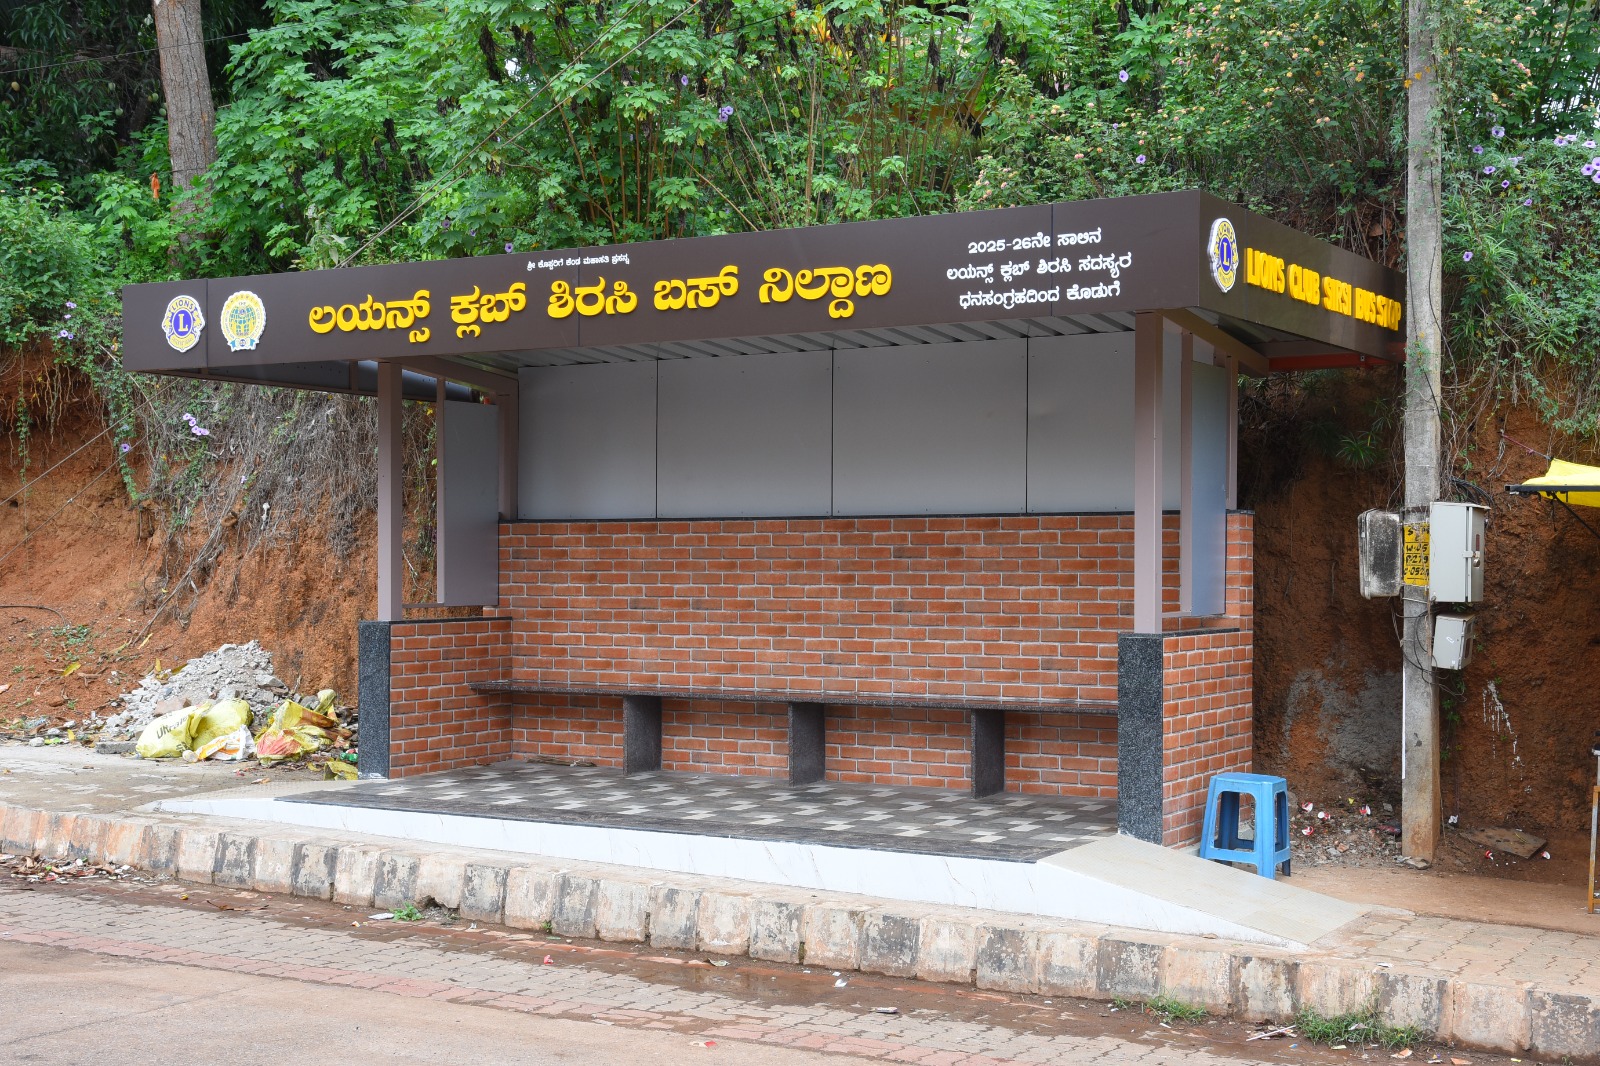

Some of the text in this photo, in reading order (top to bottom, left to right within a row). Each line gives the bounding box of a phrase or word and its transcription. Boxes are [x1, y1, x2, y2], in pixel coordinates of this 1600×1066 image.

[968, 227, 1102, 254] 2025-26ನೇ ಸಾಲಿನ
[946, 252, 1132, 283] ಲಯನ್ಸ್ ಕ್ಲಬ್ ಶಿರಸಿ ಸದಸ್ಯರ
[309, 289, 431, 343] ಲಯನ್ಸ್
[450, 281, 527, 338] ಕ್ಲಬ್
[546, 276, 638, 319] ಶಿರಸಿ
[653, 265, 739, 311] ಬಸ್
[758, 263, 893, 319] ನಿಲ್ದಾಣ
[1244, 247, 1402, 331] LIONS CLUB SIRSI BUS STOP
[171, 299, 194, 311] LIONS
[178, 313, 189, 332] L
